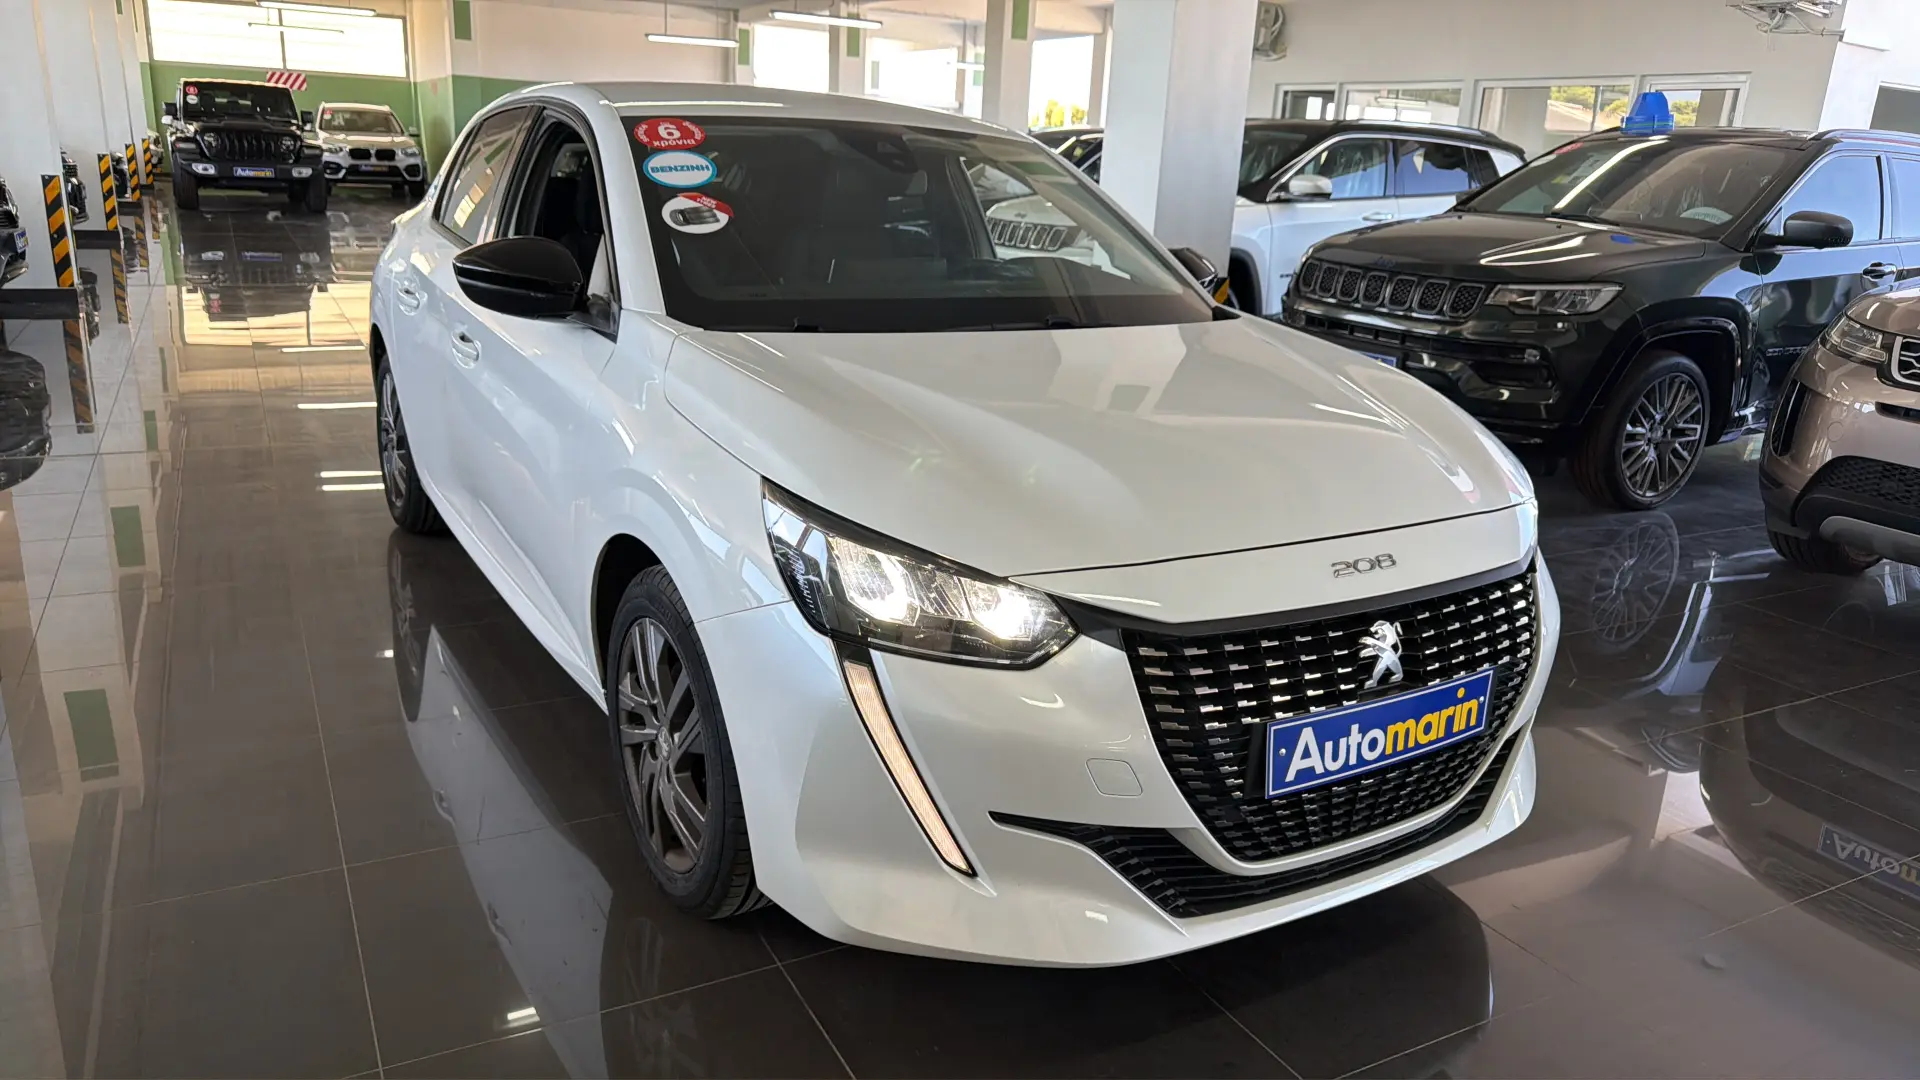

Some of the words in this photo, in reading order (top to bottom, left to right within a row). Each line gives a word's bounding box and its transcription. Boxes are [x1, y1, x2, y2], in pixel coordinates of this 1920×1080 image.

[657, 123, 681, 140] 6
[1330, 552, 1397, 579] 208
[1284, 686, 1479, 783] Automarin
